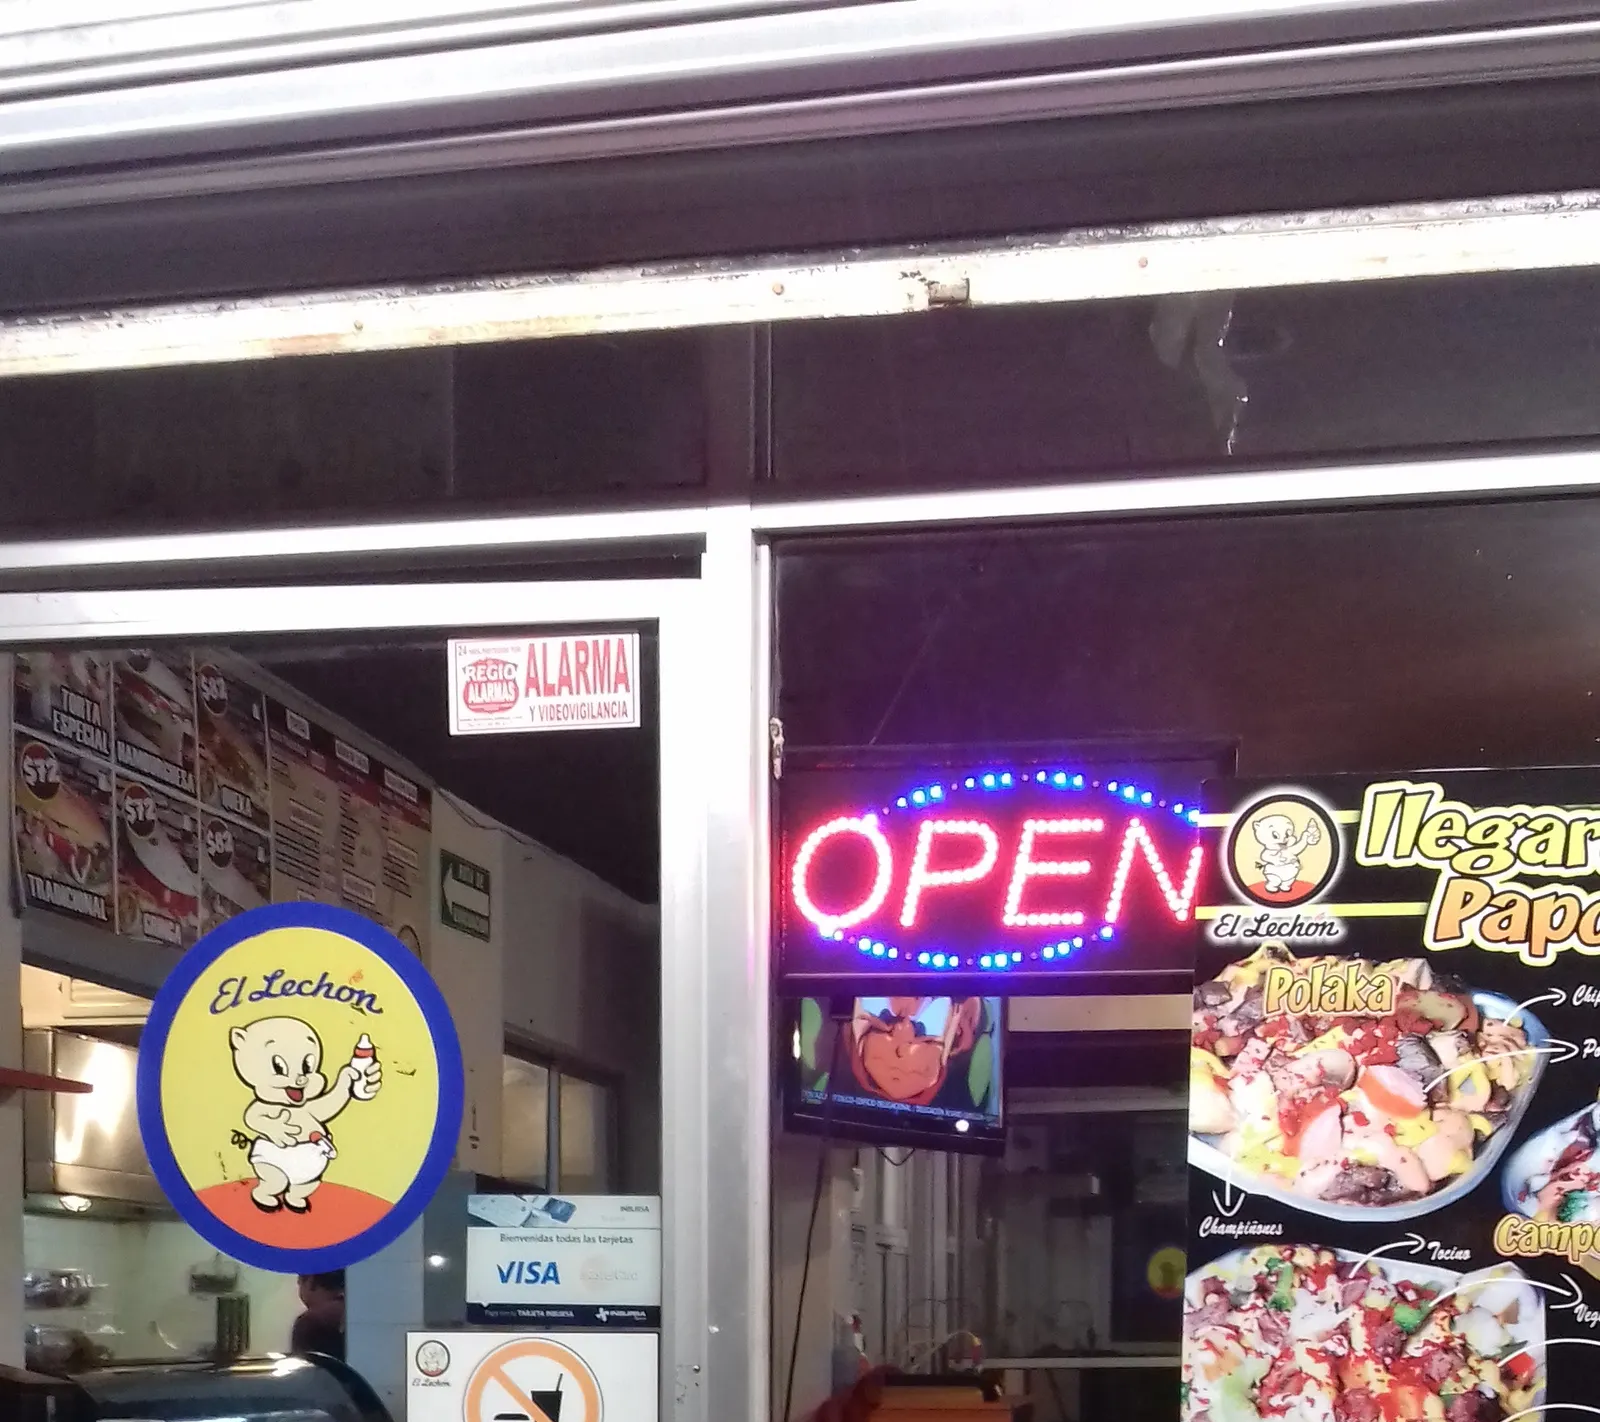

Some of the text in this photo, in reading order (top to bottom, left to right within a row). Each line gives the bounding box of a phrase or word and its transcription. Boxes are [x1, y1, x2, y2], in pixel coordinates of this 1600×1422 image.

[465, 664, 518, 681] REGIO
[525, 638, 630, 698] ALARMA
[468, 682, 516, 704] ALARMAS
[529, 705, 536, 722] Y
[539, 700, 628, 722] VIDEOVIGILANCIA
[792, 813, 1203, 930] OPEN
[1214, 913, 1238, 937] El
[209, 976, 247, 1015] El
[1264, 962, 1394, 1016] Polaka
[1199, 1216, 1282, 1238] Champiñones
[500, 1233, 633, 1246] Bienvenidas todas las tarjetas
[1428, 1241, 1471, 1261] Tocino
[497, 1261, 560, 1285] VISA
[1573, 1303, 1600, 1329] Veg
